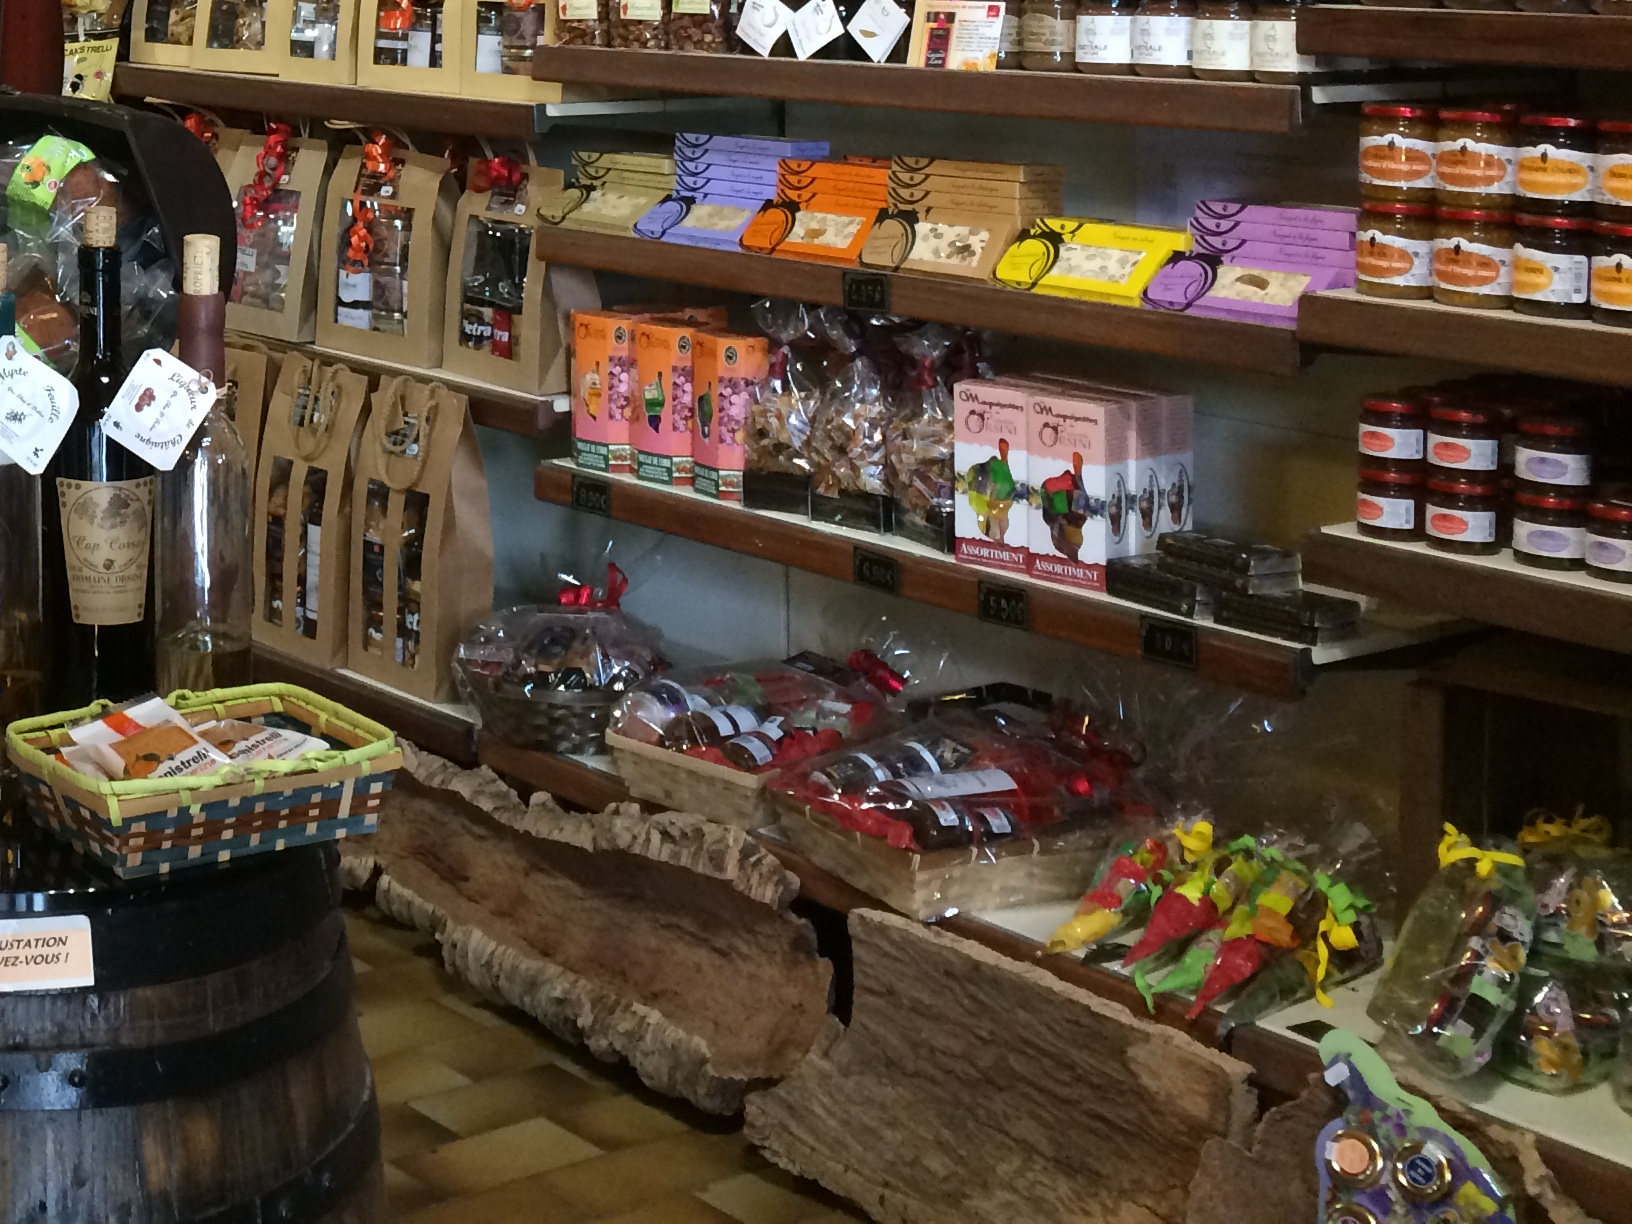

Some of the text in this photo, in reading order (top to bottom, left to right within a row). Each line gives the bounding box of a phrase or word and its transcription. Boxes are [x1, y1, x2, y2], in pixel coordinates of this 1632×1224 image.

[168, 372, 197, 411] Liqueur
[134, 432, 184, 451] Châtaigne
[76, 536, 101, 555] Cap
[960, 542, 1024, 564] ASSORTIMENT
[1034, 559, 1100, 581] ASSORTIMENT
[157, 747, 211, 779] nistrelli
